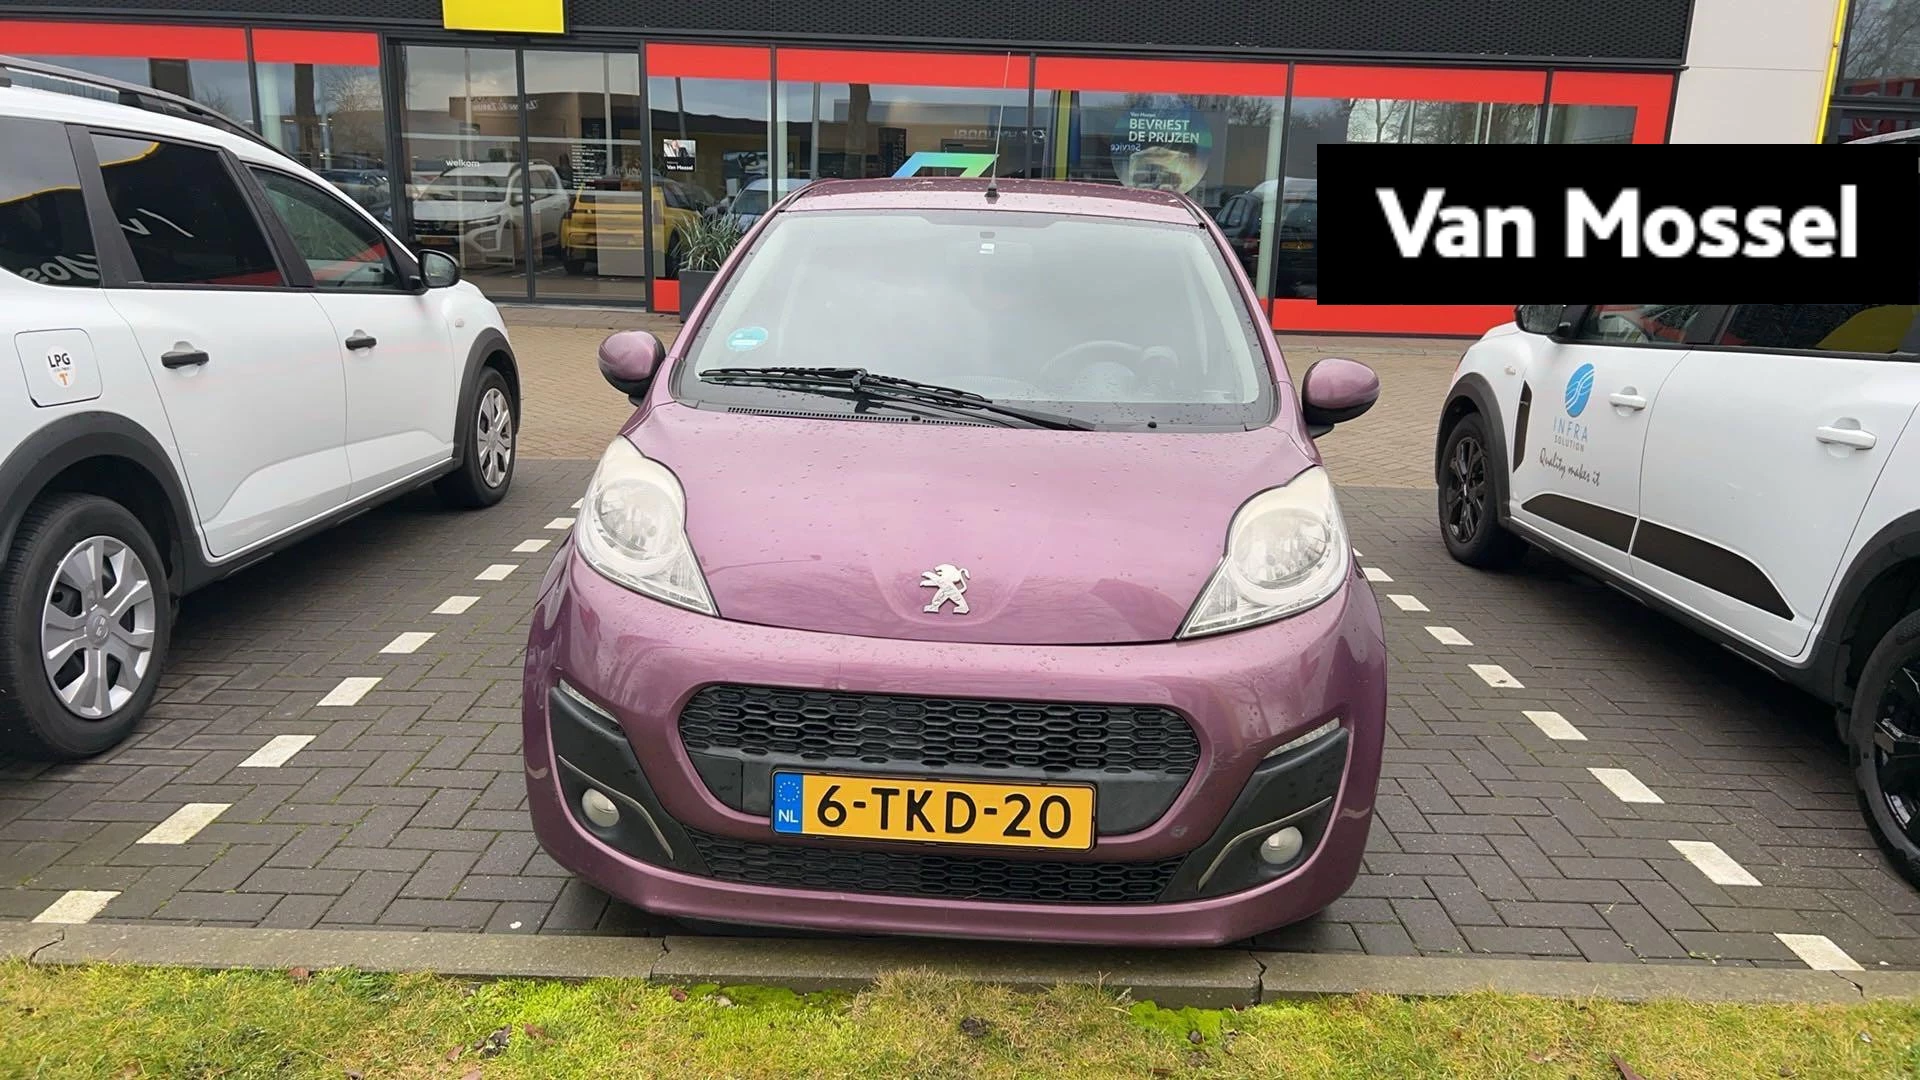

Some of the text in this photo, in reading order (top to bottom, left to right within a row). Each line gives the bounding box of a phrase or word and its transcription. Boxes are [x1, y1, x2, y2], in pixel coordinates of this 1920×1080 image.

[1129, 118, 1190, 130] BEVRIEST
[1128, 131, 1200, 144] DE PRIJZEN
[445, 159, 480, 168] welkom
[47, 352, 71, 368] LPG
[1553, 416, 1588, 443] INFRA
[1554, 434, 1584, 453] SOLUTION
[1539, 447, 1566, 479] Quality
[778, 784, 1072, 840] NL 6-TKD-20
